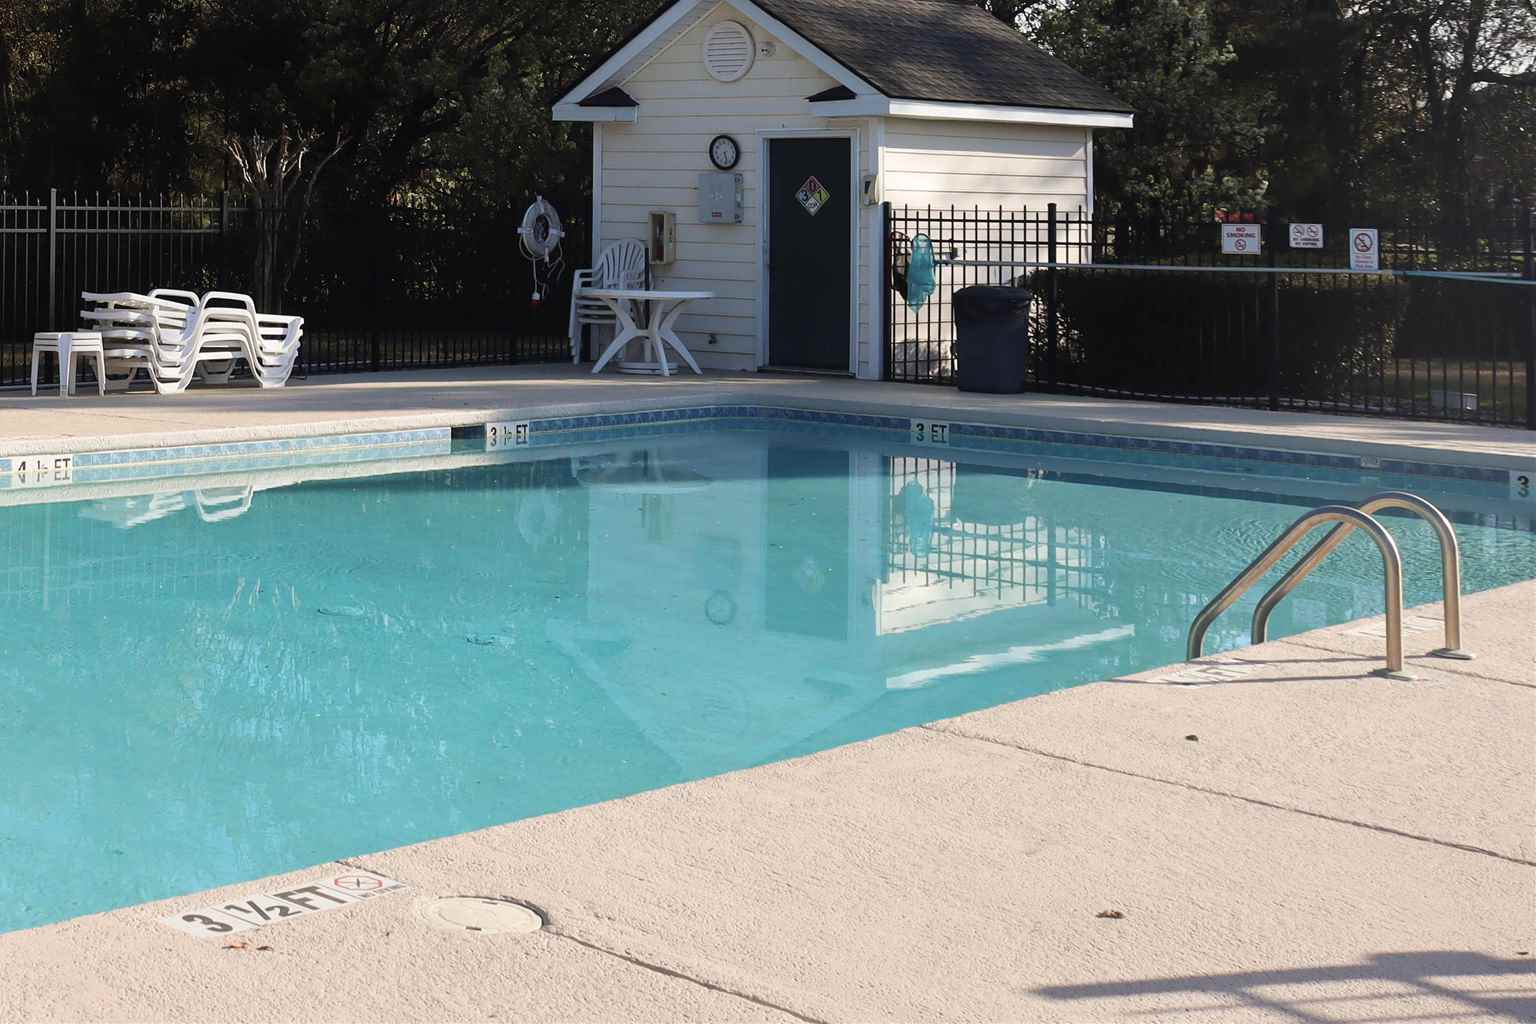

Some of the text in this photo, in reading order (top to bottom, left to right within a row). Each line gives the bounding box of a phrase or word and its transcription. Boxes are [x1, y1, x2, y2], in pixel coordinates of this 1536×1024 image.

[800, 191, 808, 202] 3
[182, 913, 233, 932] 3
[273, 885, 347, 911] FT
